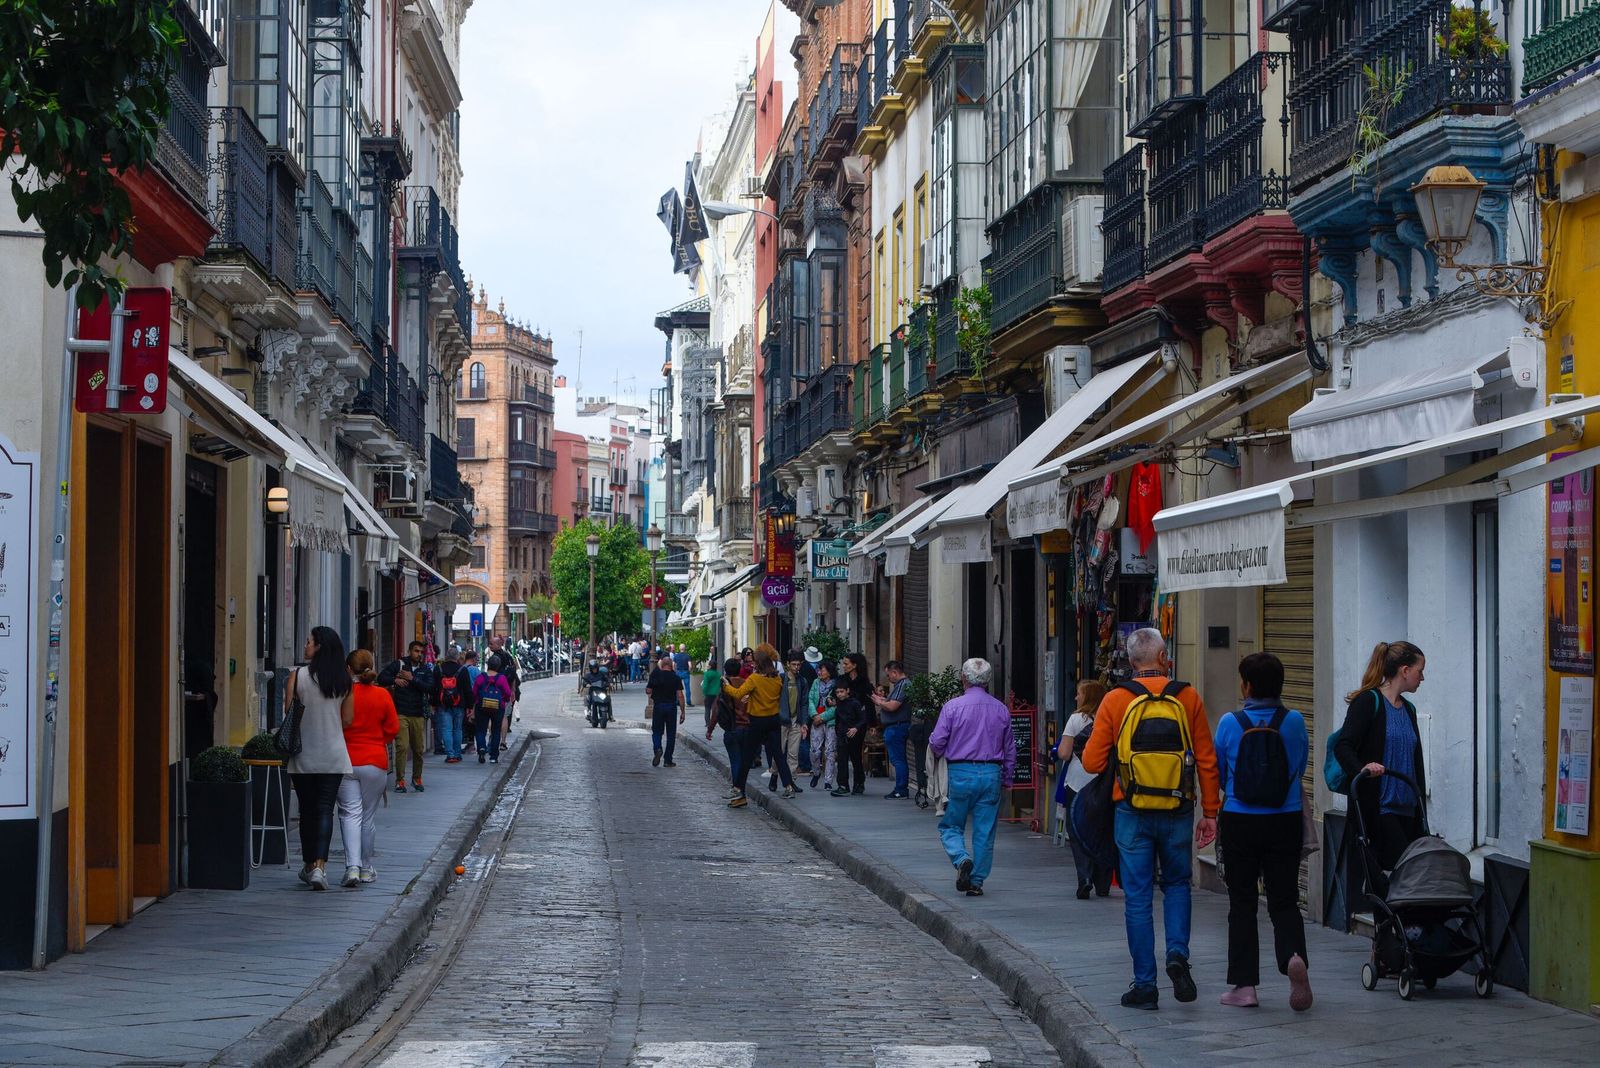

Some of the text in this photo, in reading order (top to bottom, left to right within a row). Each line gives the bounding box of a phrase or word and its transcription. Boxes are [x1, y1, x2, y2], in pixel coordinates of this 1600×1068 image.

[684, 192, 702, 233] OBU
[815, 569, 829, 578] BAR
[767, 584, 789, 596] açaí
